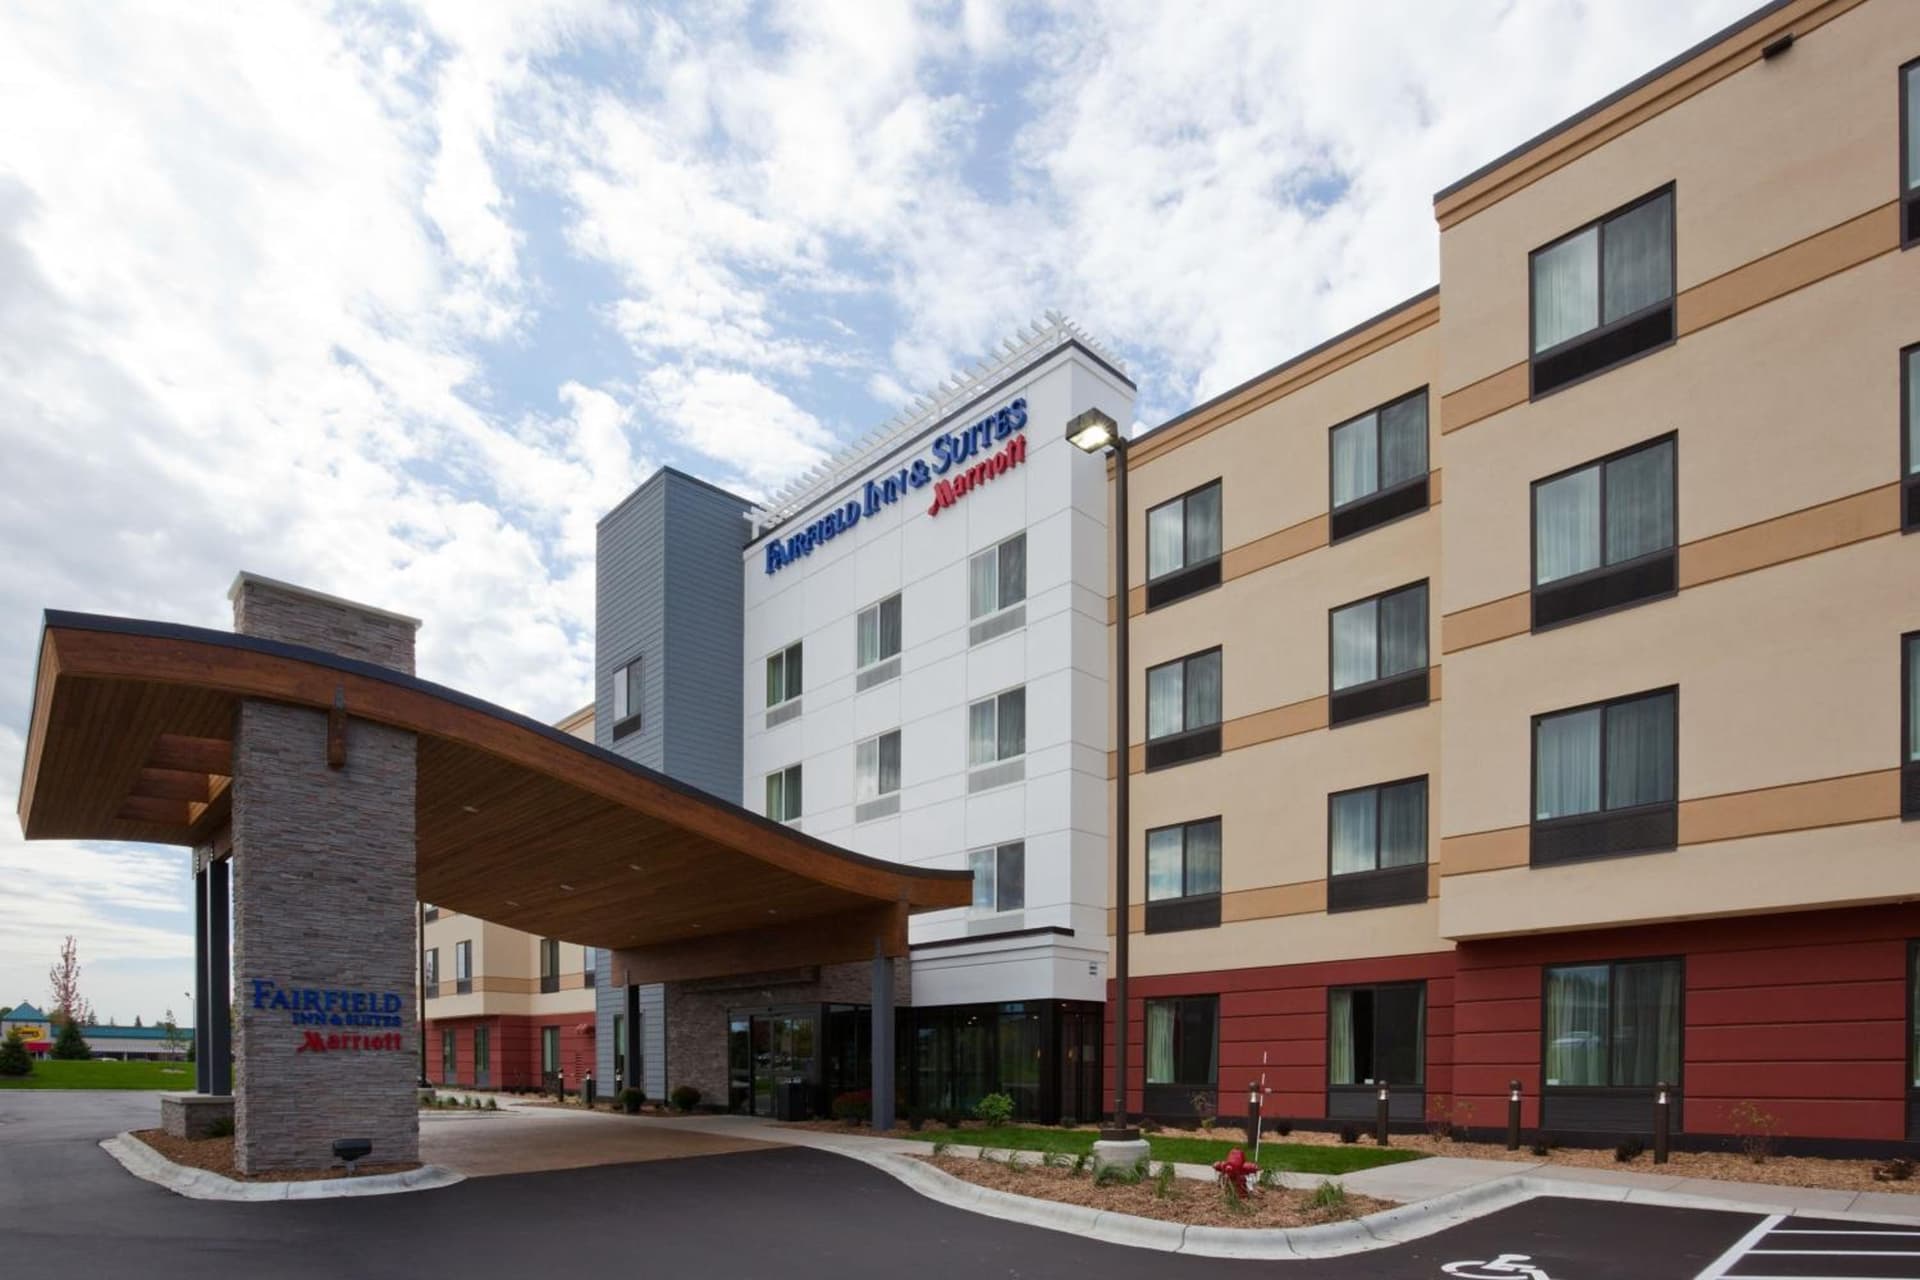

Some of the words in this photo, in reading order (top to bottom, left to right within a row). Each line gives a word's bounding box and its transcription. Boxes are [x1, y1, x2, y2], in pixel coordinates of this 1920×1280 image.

[765, 499, 862, 575] FAIRFIELD
[862, 468, 909, 518] INN
[931, 397, 1029, 475] SUITES
[928, 433, 1027, 517] Marriott
[252, 979, 402, 1013] FAIRFIELD
[293, 1012, 327, 1025] INN
[346, 1014, 402, 1027] SUITES
[297, 1030, 402, 1052] Marriott
